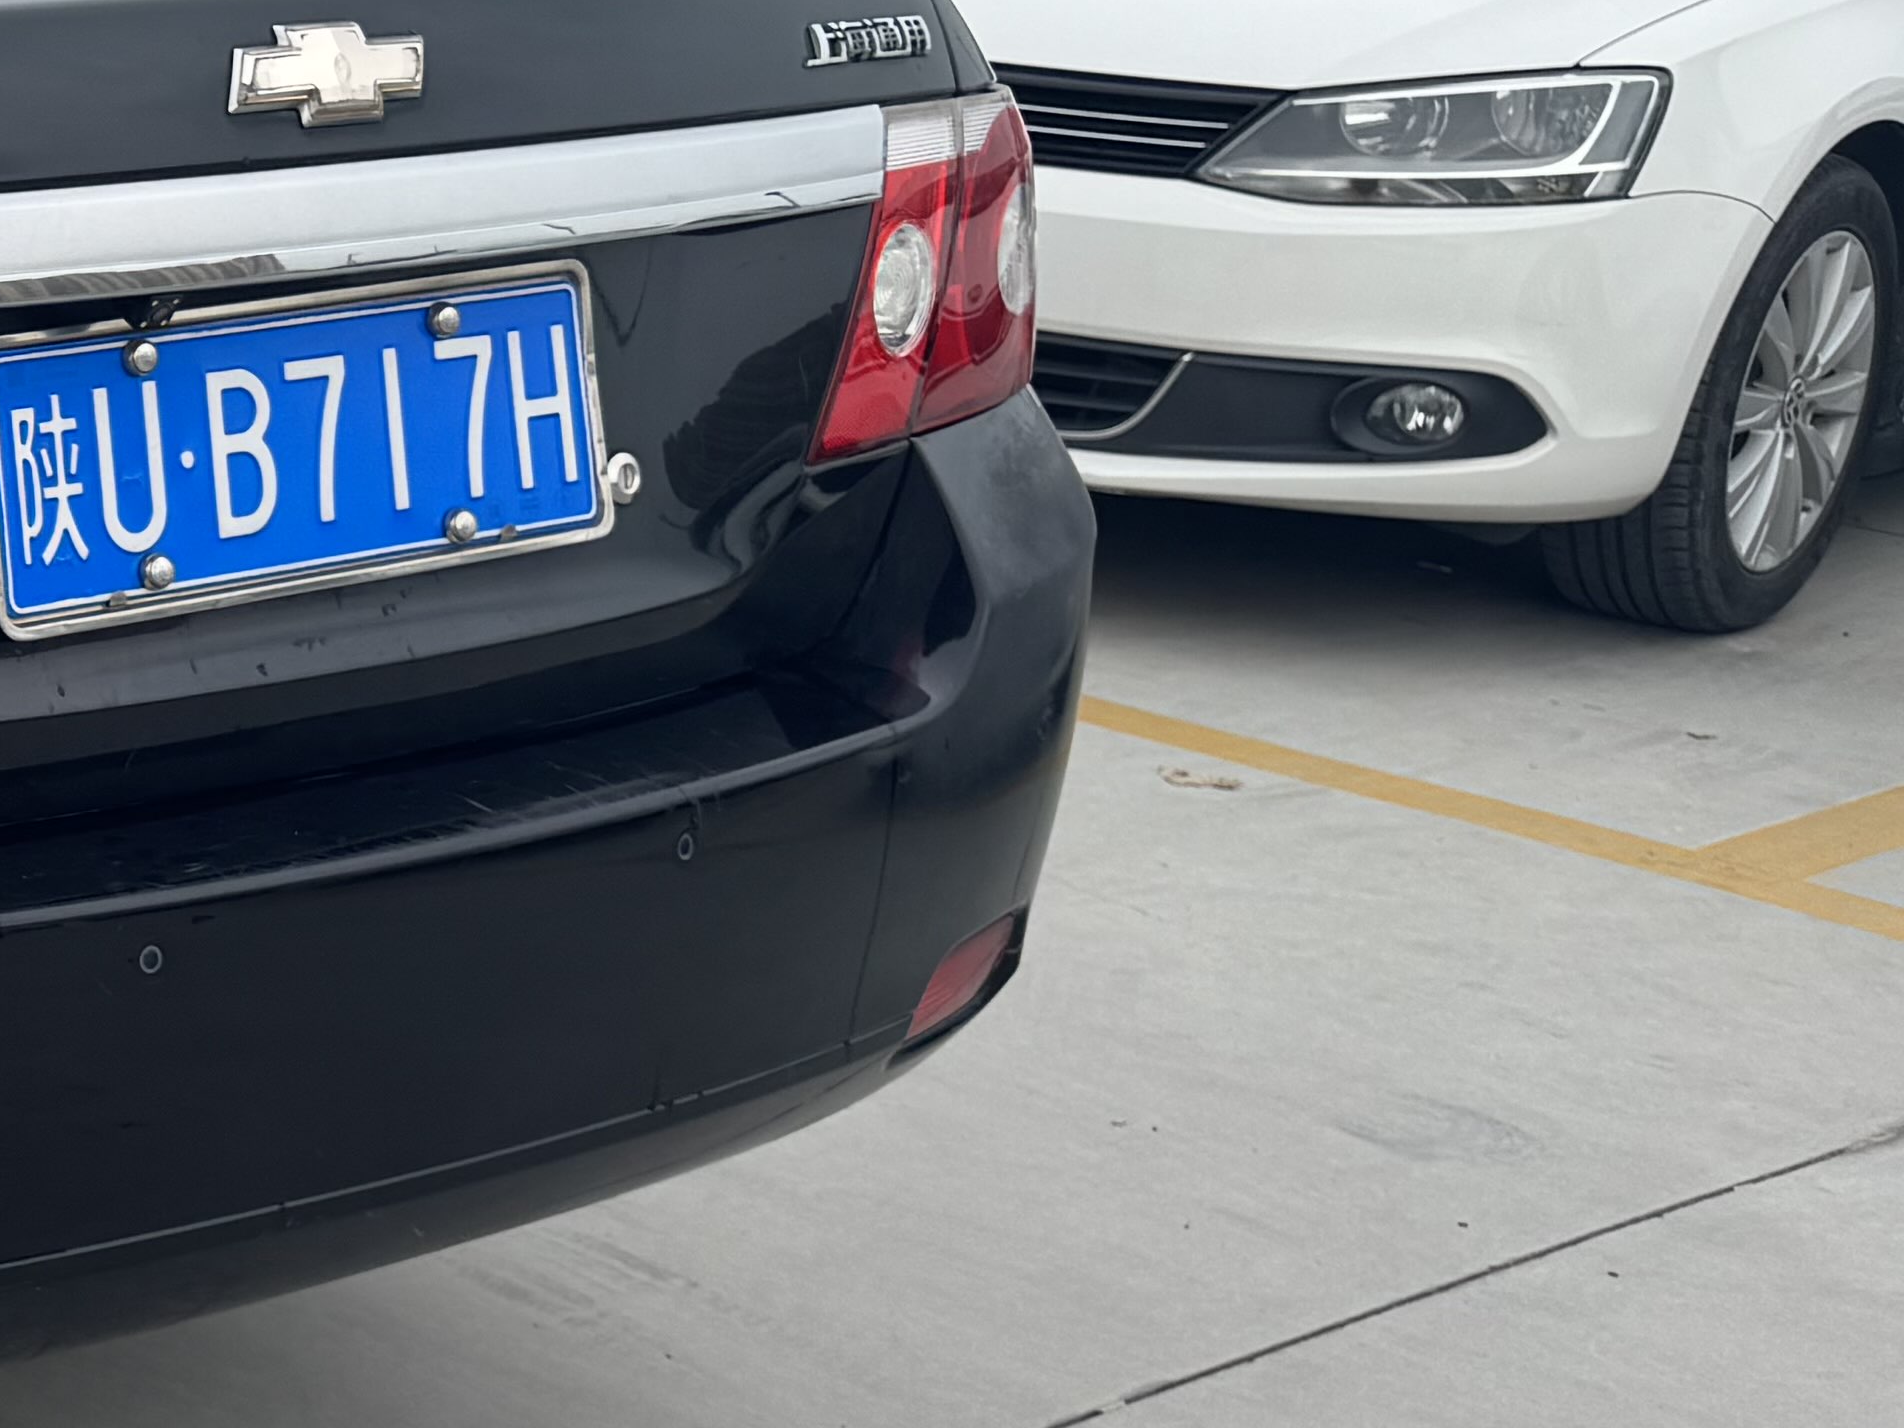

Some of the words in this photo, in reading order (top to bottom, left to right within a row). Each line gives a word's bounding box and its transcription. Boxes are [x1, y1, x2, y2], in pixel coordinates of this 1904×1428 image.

[804, 14, 933, 68] 上海通用
[9, 323, 579, 568] 陕U·B717H
